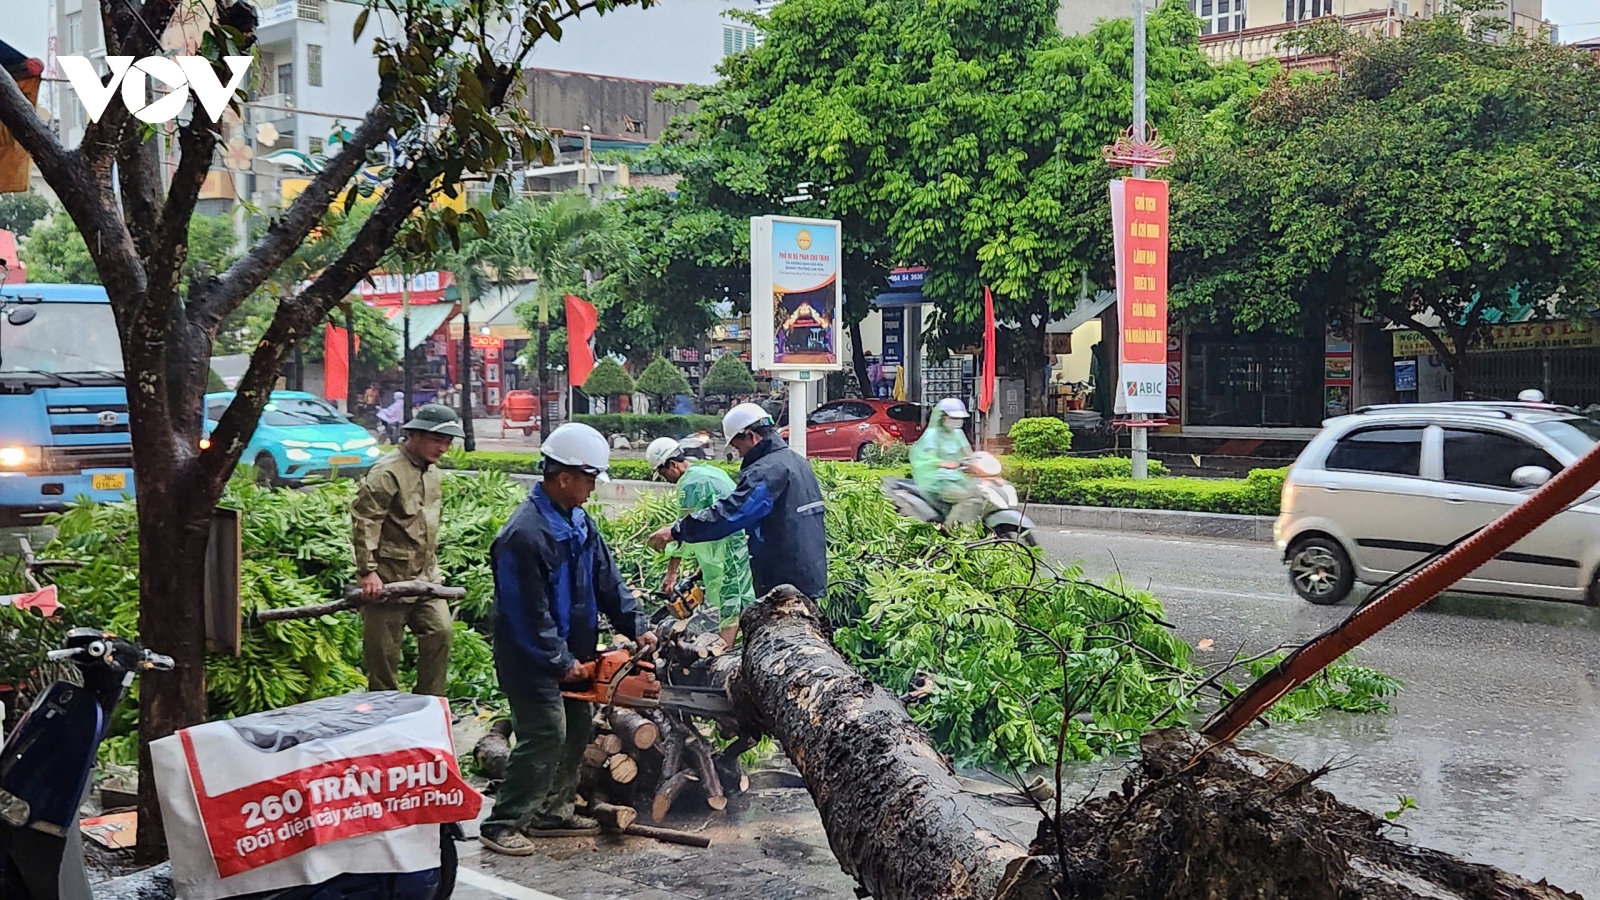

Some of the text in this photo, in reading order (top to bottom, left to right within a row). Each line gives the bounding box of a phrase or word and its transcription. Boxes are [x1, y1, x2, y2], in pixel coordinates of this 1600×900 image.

[1140, 382, 1162, 393] ABIC
[236, 788, 464, 856] (Đối diện cây xăng Trần Phú)
[241, 754, 448, 829] 260 TRẦN PHÚ
